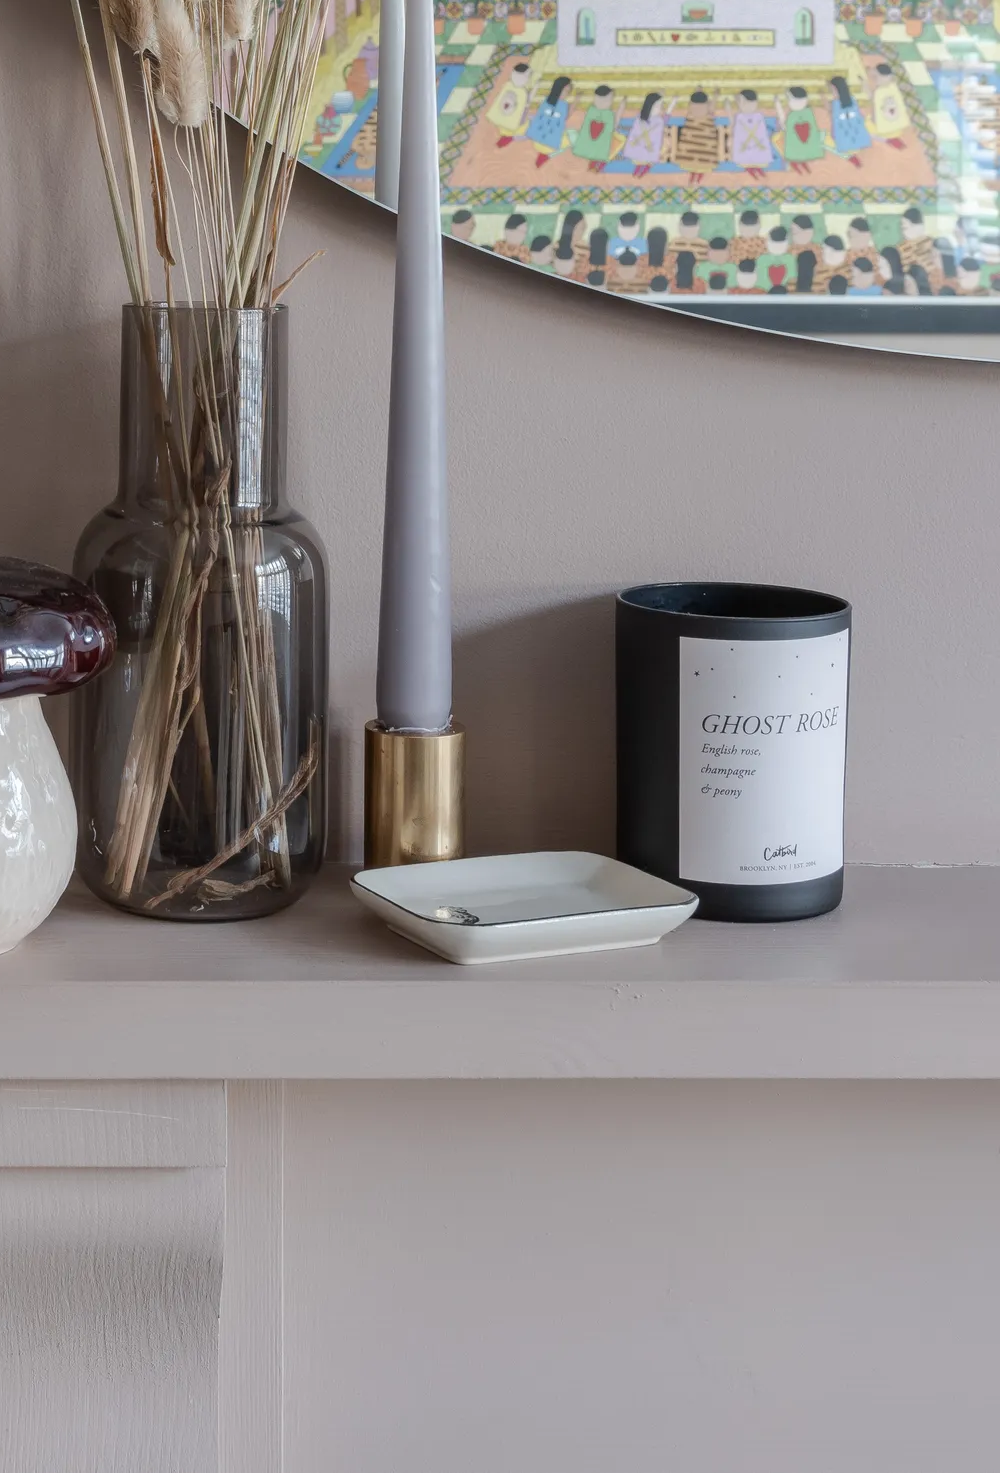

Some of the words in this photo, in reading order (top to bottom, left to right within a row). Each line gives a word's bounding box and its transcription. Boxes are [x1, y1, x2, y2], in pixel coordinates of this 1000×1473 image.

[701, 712, 792, 735] GHOST
[795, 705, 840, 733] ROSE
[701, 743, 738, 758] English
[740, 747, 761, 756] rose,
[700, 764, 756, 778] champagne
[701, 783, 712, 794] &
[713, 787, 743, 798] peony
[763, 844, 798, 861] Catbird
